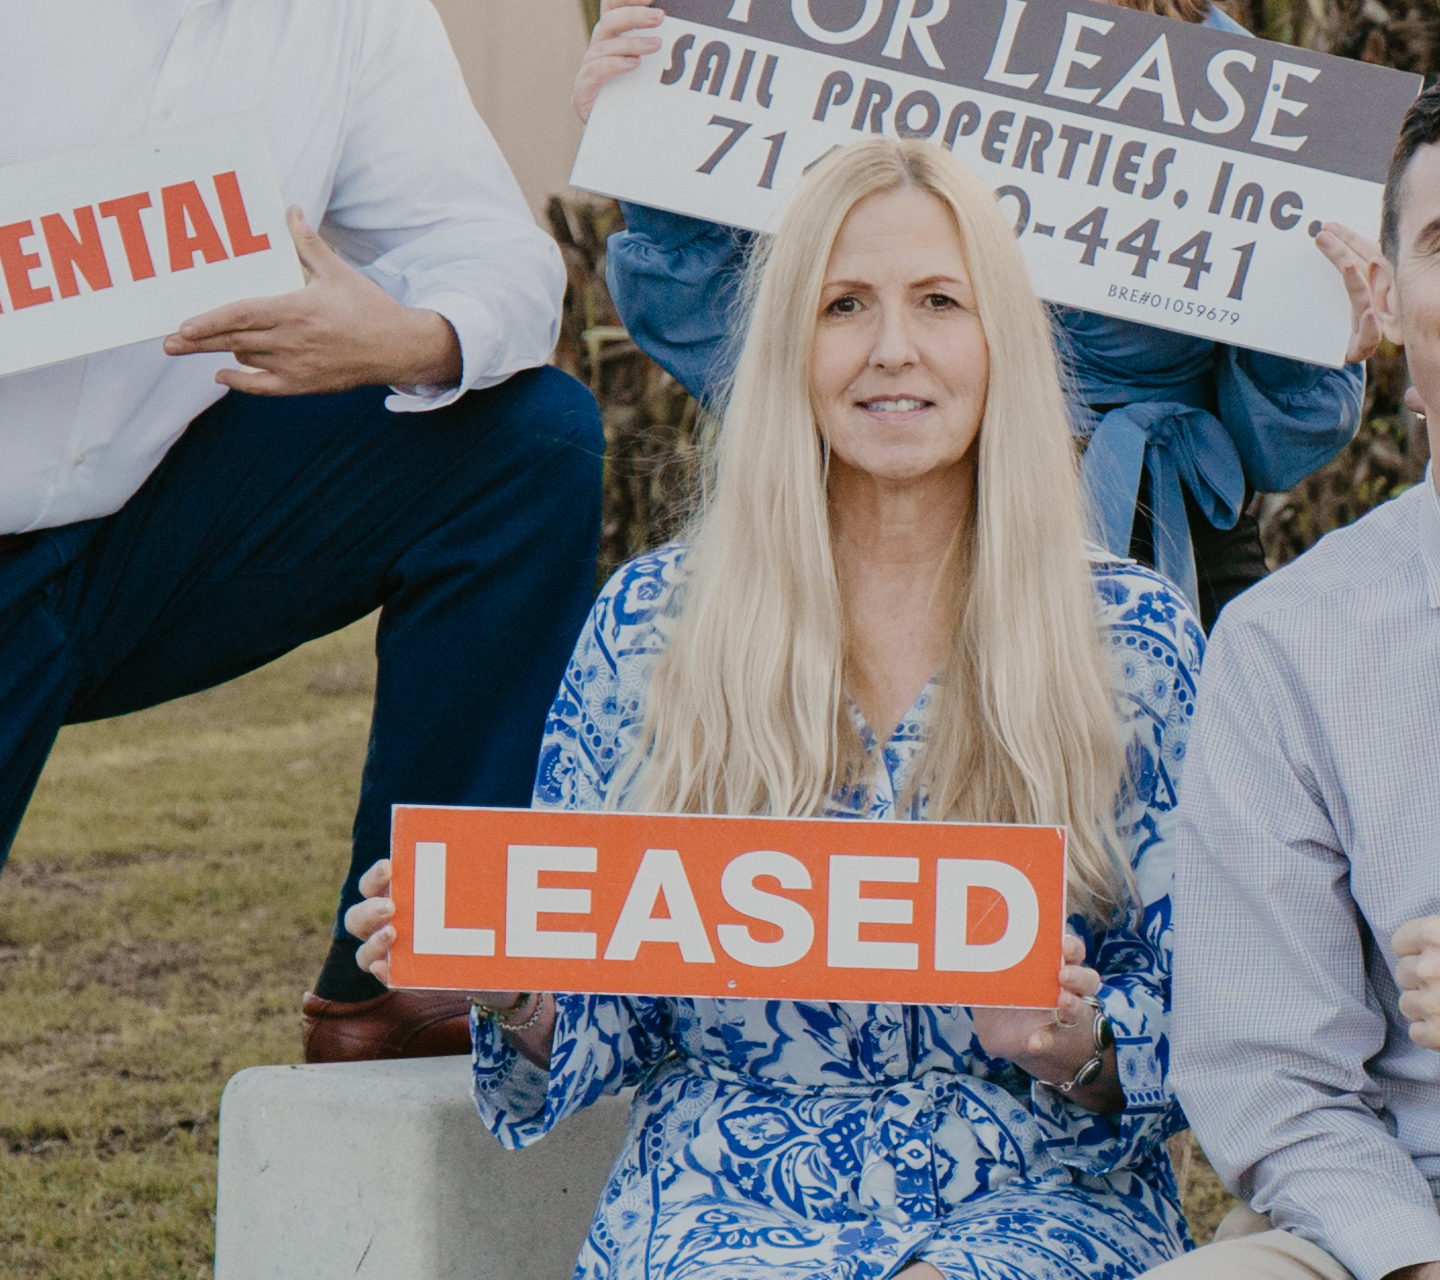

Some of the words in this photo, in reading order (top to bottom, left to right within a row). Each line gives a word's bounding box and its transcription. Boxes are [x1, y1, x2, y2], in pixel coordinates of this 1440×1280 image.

[660, 33, 780, 110] SAIL
[1209, 161, 1326, 239] Inc.
[1107, 283, 1241, 326] BRE#01059679
[412, 840, 1040, 973] LEASED
